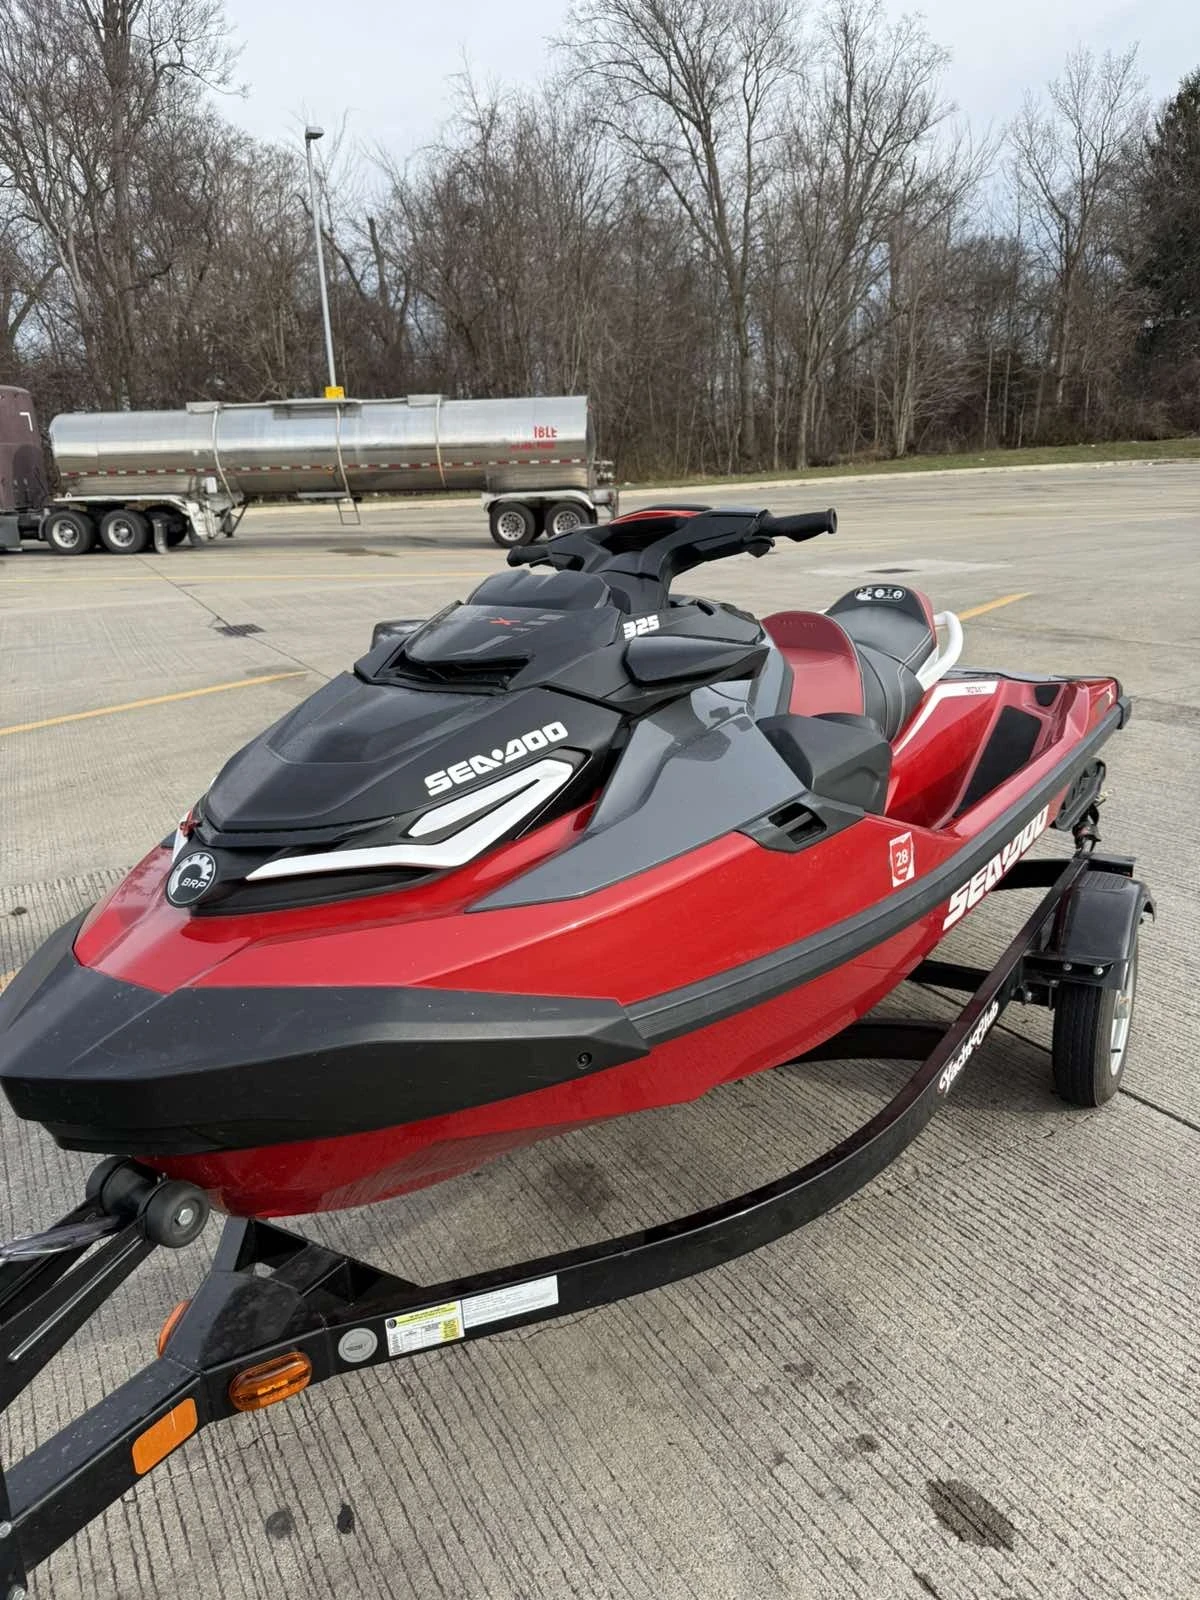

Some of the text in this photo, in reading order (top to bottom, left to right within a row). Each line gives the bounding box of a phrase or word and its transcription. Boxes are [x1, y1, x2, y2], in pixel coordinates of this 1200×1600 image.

[622, 614, 660, 640] 325
[896, 848, 909, 867] 28
[180, 877, 207, 889] BRP
